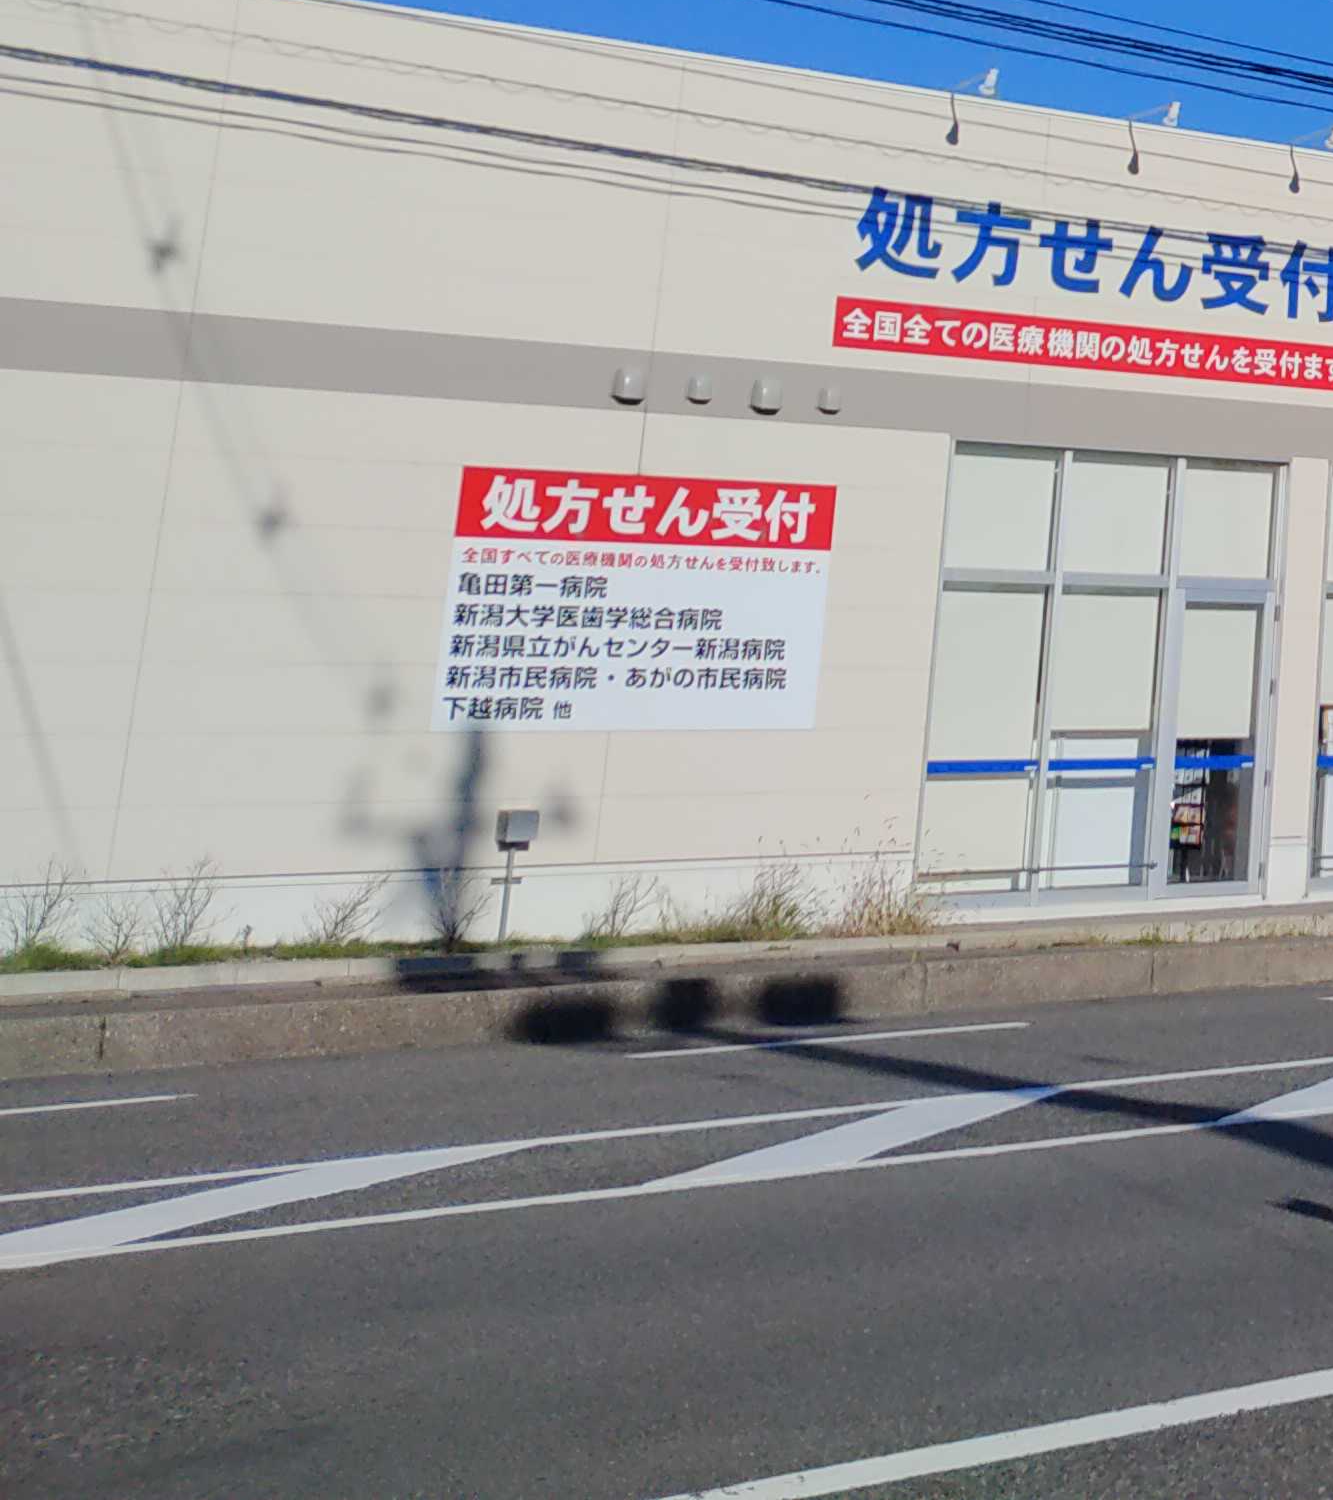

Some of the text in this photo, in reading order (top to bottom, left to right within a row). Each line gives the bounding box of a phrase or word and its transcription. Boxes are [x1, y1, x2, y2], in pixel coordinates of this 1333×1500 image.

[480, 475, 816, 543] 処方せん受付
[458, 572, 609, 599] 亀田第一病院
[453, 603, 723, 631] 新潟大学医歯学総合病院
[449, 634, 785, 662] 新潟県立がんセンター新潟病院
[443, 697, 573, 721] 下越病院 他
